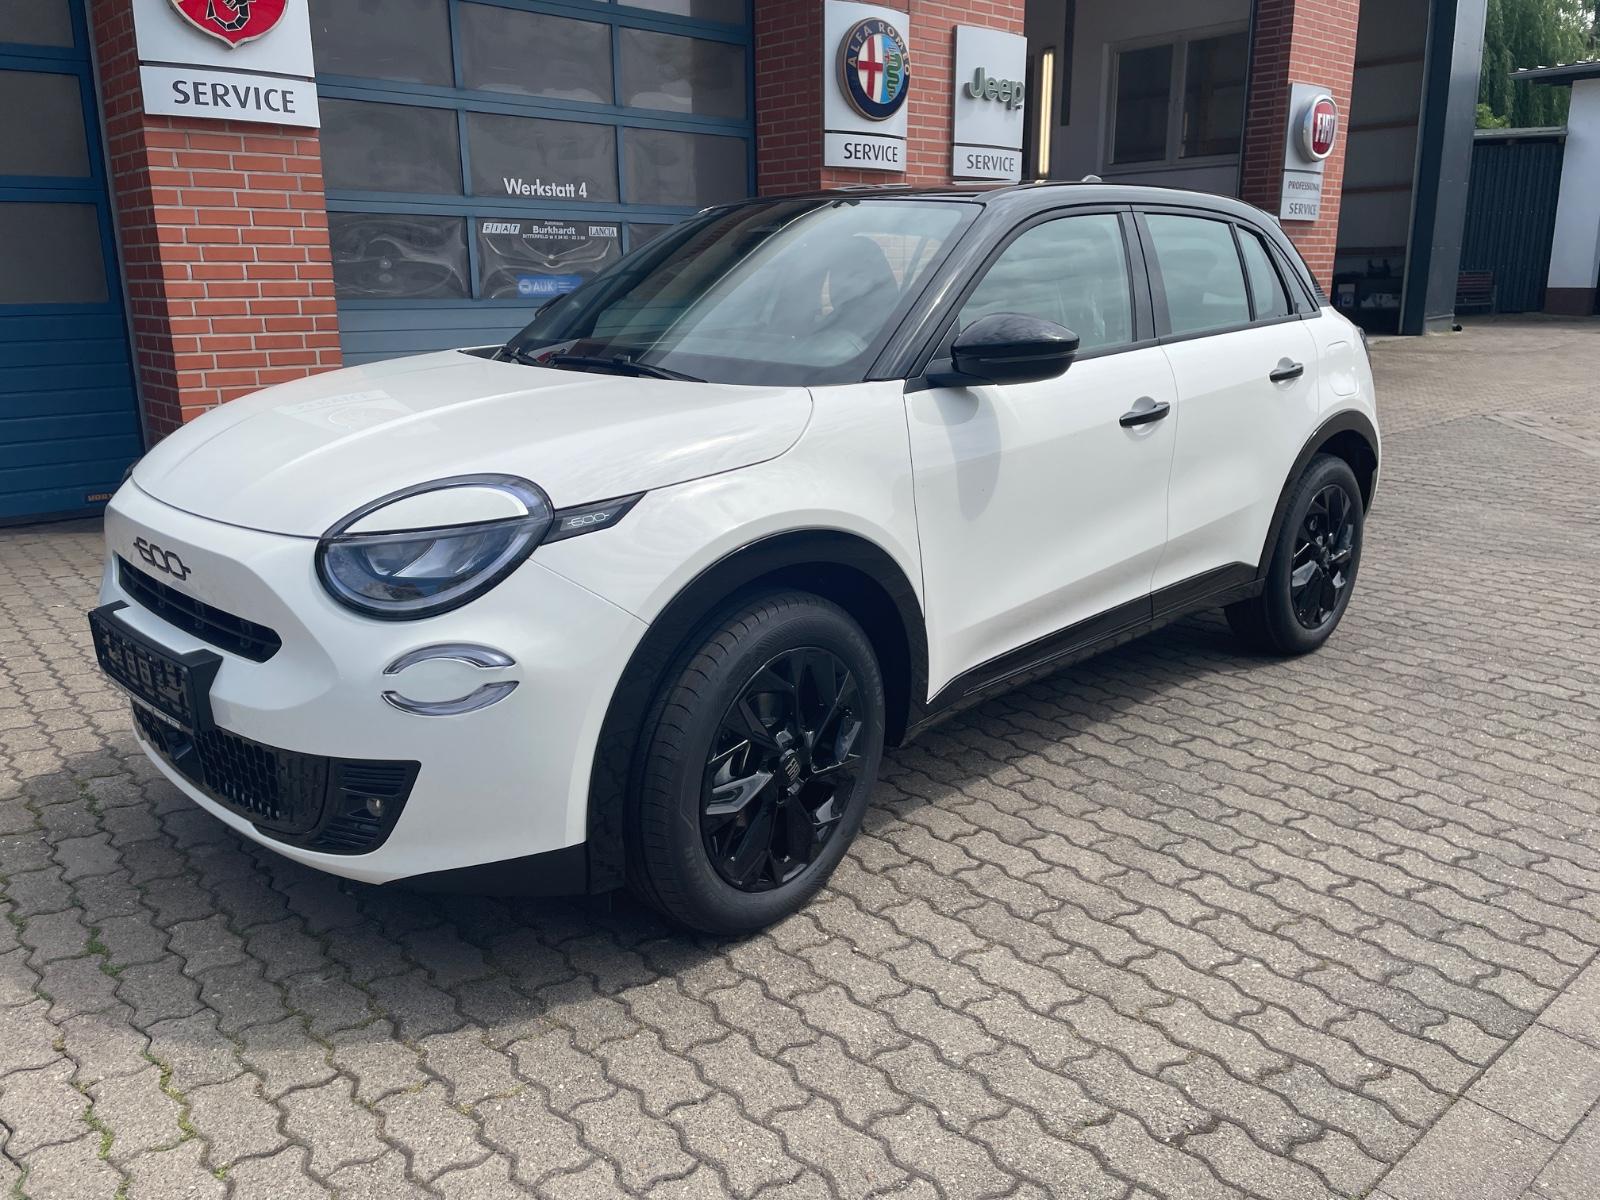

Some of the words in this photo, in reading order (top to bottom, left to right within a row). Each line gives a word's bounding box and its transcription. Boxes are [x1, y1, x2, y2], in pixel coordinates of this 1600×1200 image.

[847, 24, 873, 68] ALFA
[878, 22, 910, 76] ROMEO
[172, 80, 296, 114] SERVICE
[964, 66, 1025, 110] Jeep
[1315, 112, 1335, 143] FIAT
[844, 142, 898, 163] SERVICE
[966, 154, 1015, 172] SERVICE
[503, 177, 576, 198] Werkstatt
[579, 182, 588, 198] 4
[1287, 180, 1320, 192] PROFESSIONAL
[1288, 202, 1318, 215] SERVICE
[482, 222, 521, 235] FIAT
[532, 225, 576, 235] Burkhardt
[589, 226, 617, 237] LANCIA
[133, 536, 192, 581] 600
